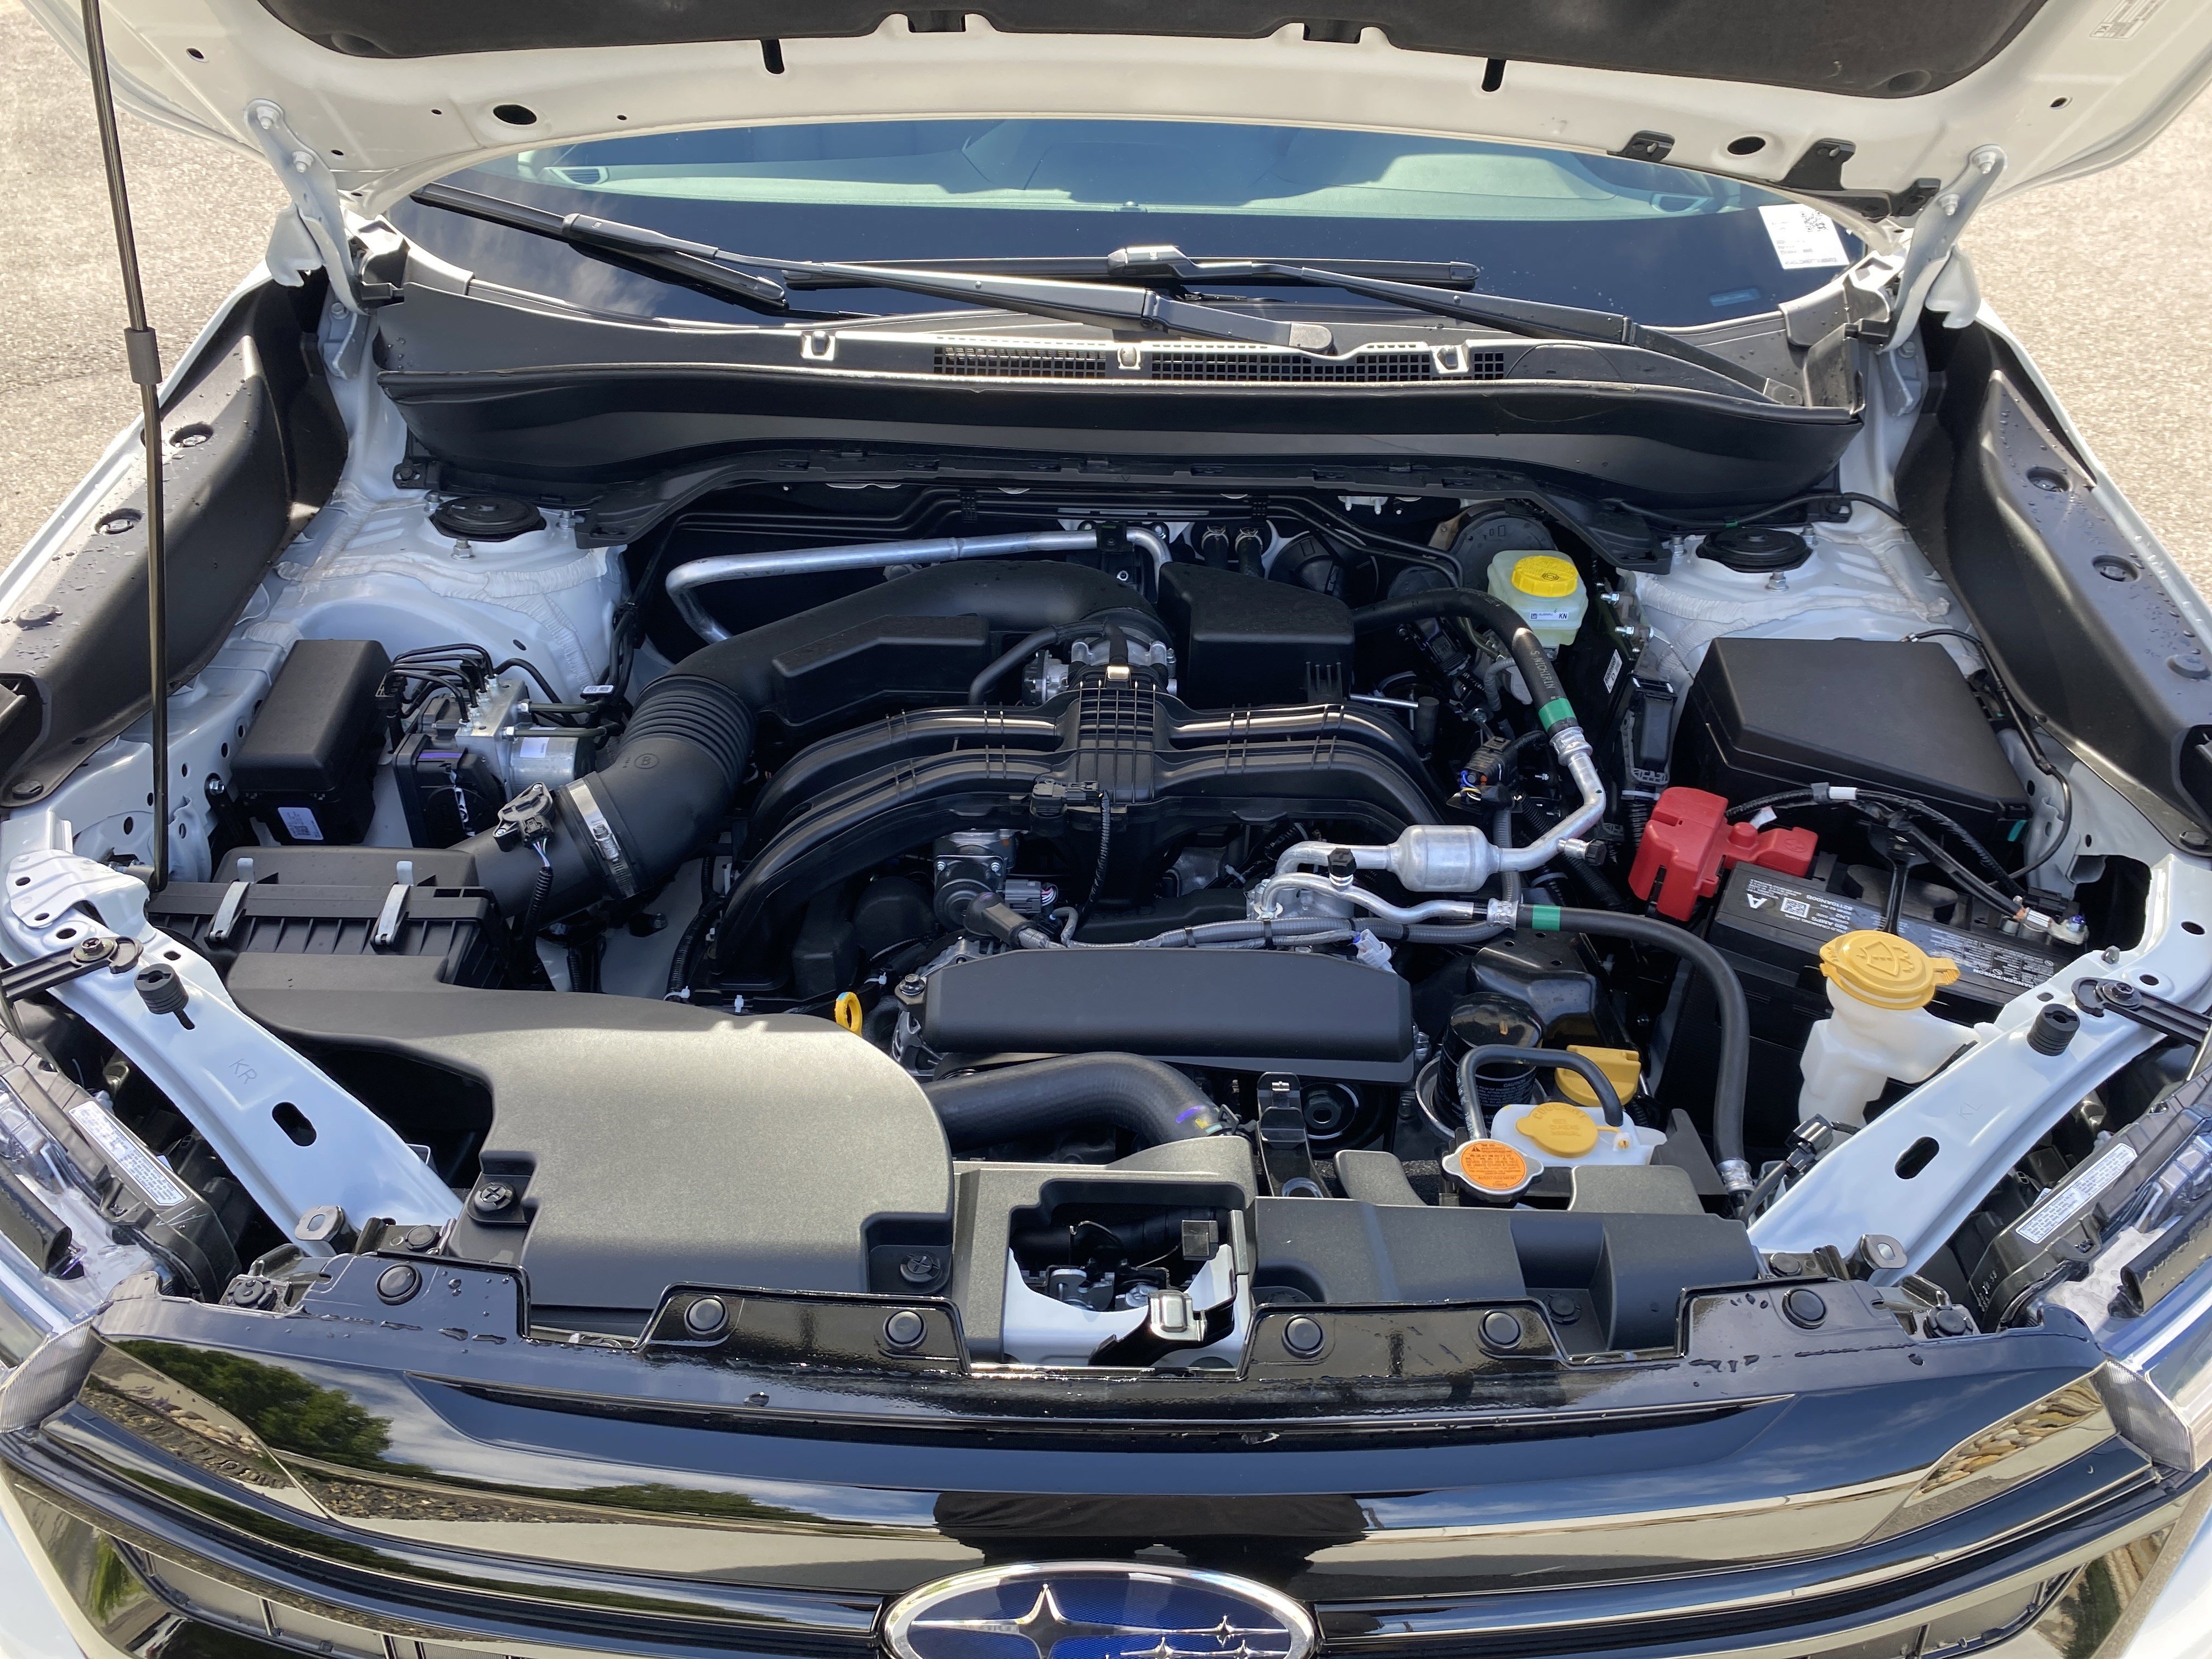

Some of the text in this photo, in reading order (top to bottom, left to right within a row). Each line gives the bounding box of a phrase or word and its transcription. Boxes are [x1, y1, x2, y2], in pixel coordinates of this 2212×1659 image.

[1746, 893, 1768, 909] A
[1811, 916, 1833, 926] AMPS
[228, 1058, 257, 1085] KR
[1533, 1104, 1587, 1119] COOLANT
[1957, 1102, 1983, 1120] KL
